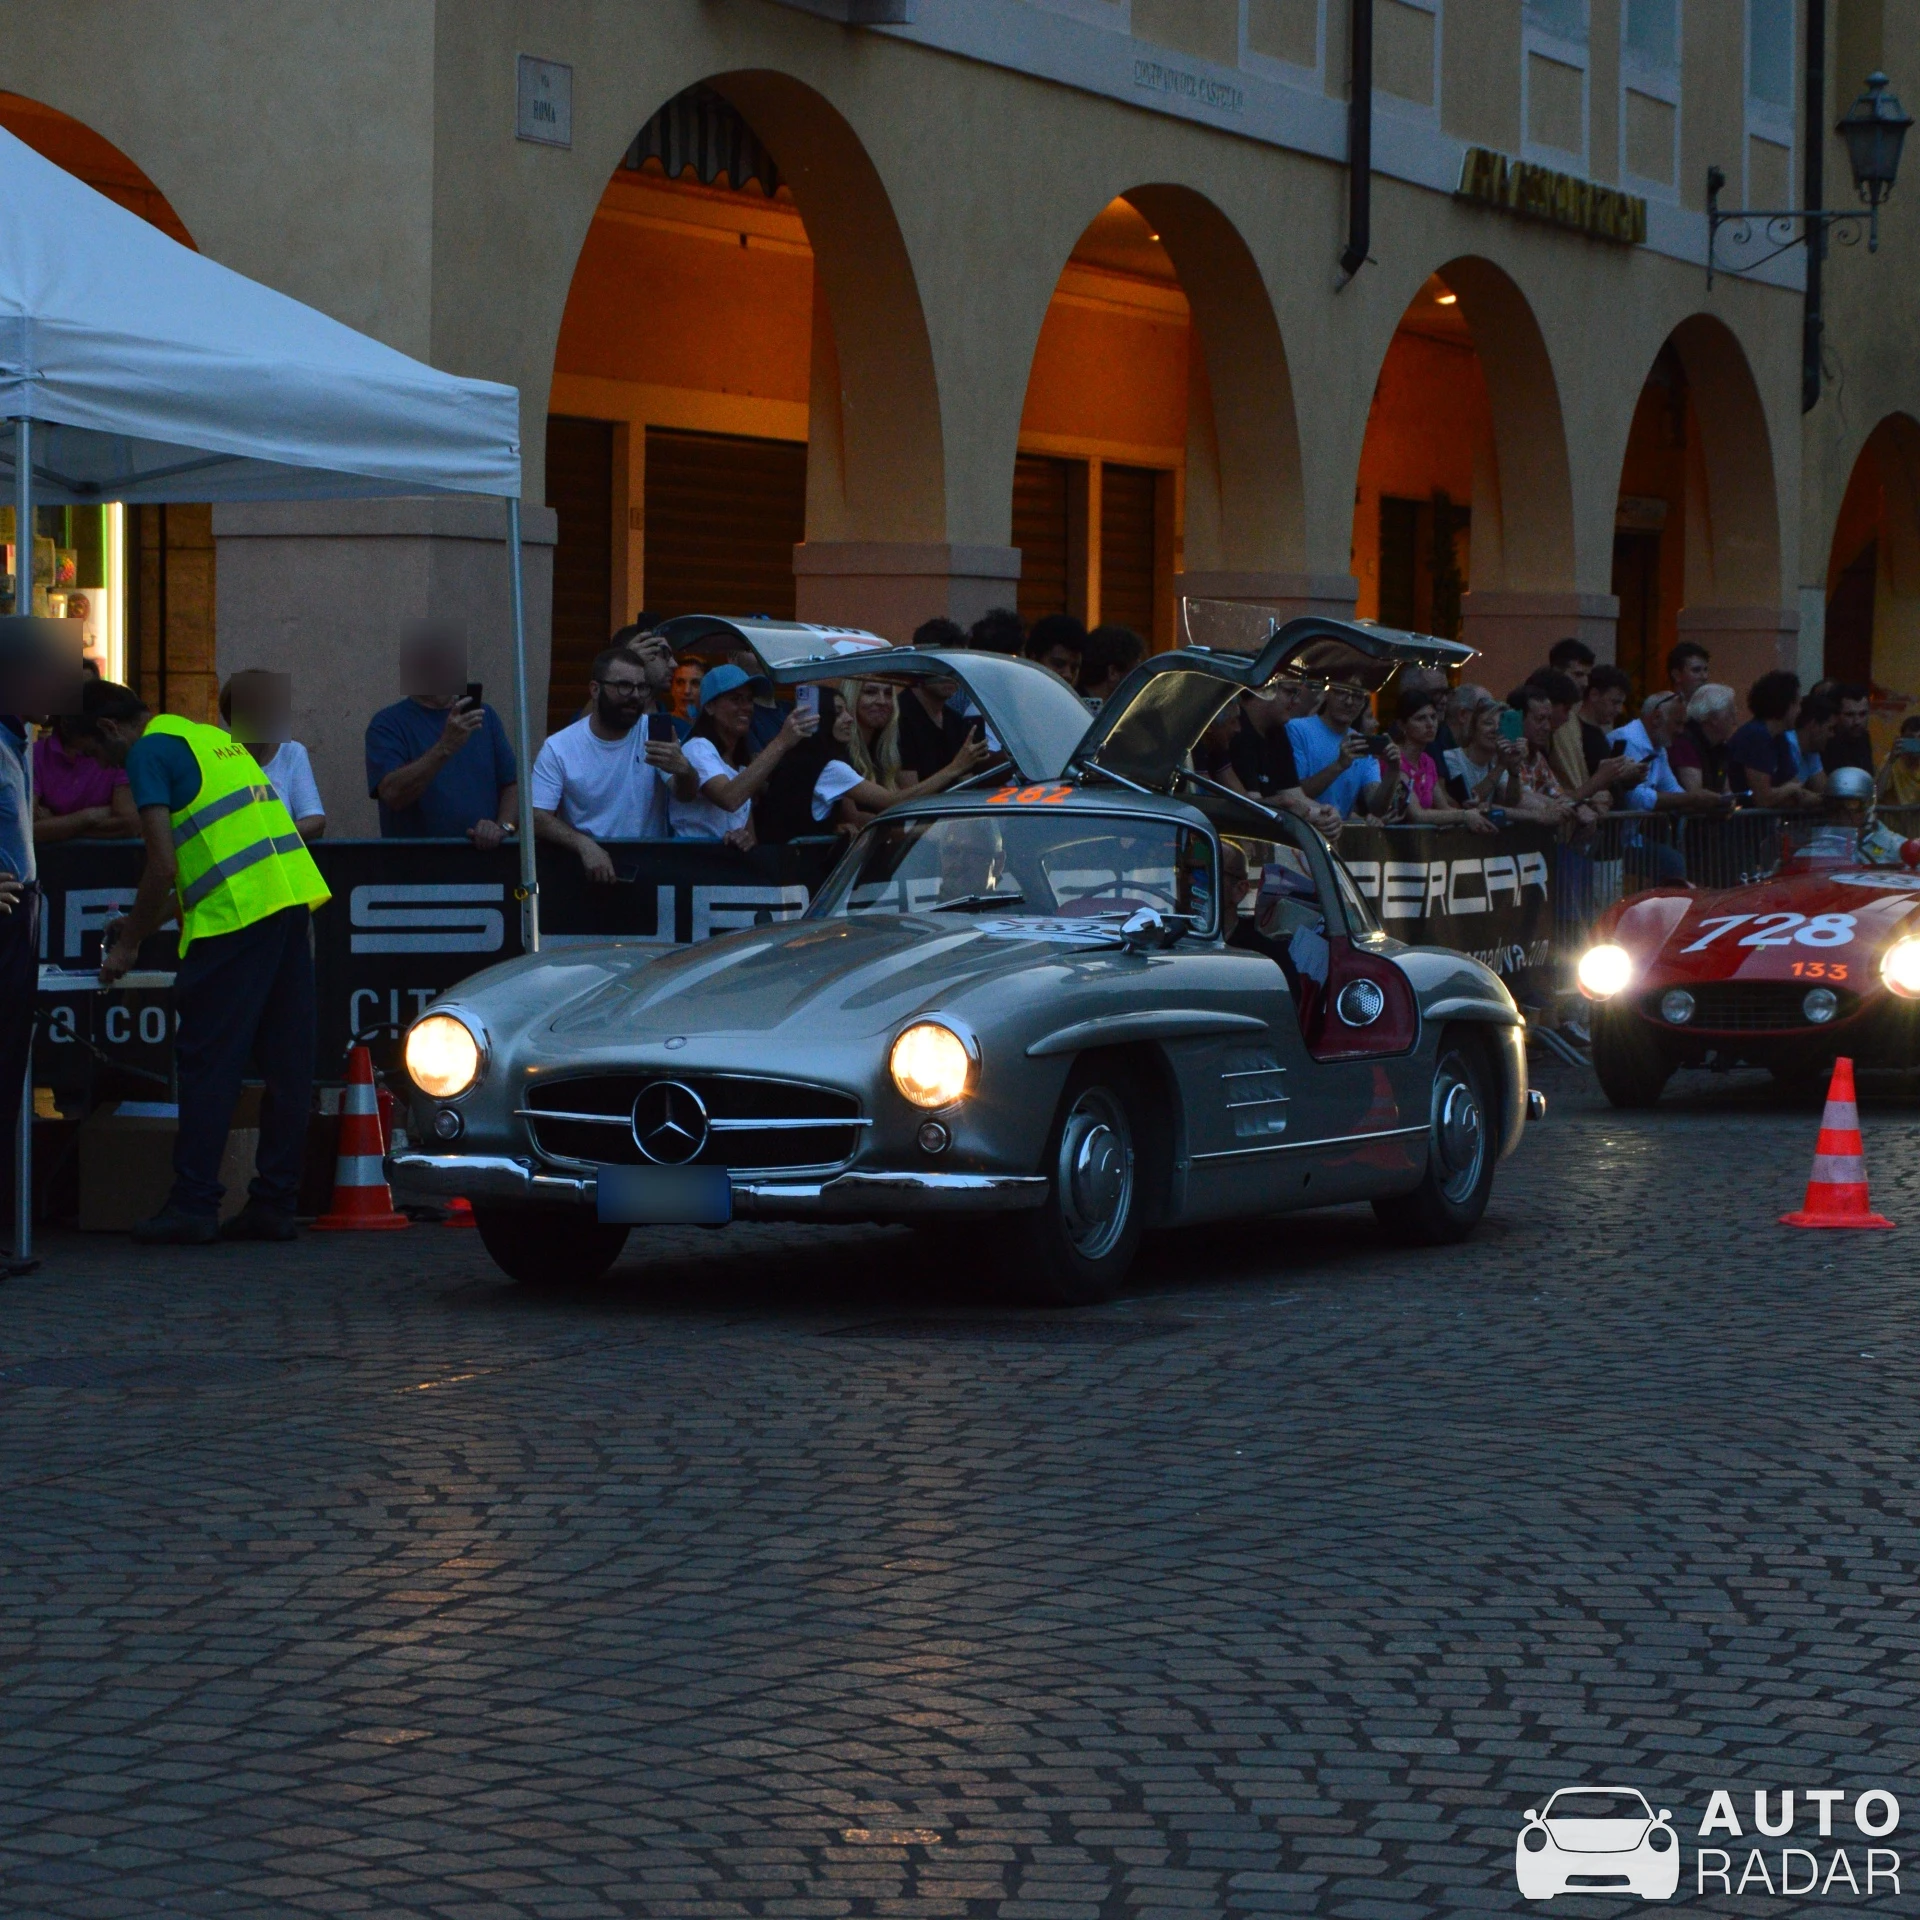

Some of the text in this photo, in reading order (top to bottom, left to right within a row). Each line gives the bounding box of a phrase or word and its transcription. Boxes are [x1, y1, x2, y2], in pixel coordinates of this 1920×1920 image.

[533, 100, 556, 123] ROMA
[986, 785, 1073, 803] 282
[1335, 851, 1548, 919] PERCAR
[996, 921, 1102, 936] 282
[1680, 911, 1858, 954] 728
[1791, 961, 1848, 981] 133
[350, 987, 447, 1040] CIT
